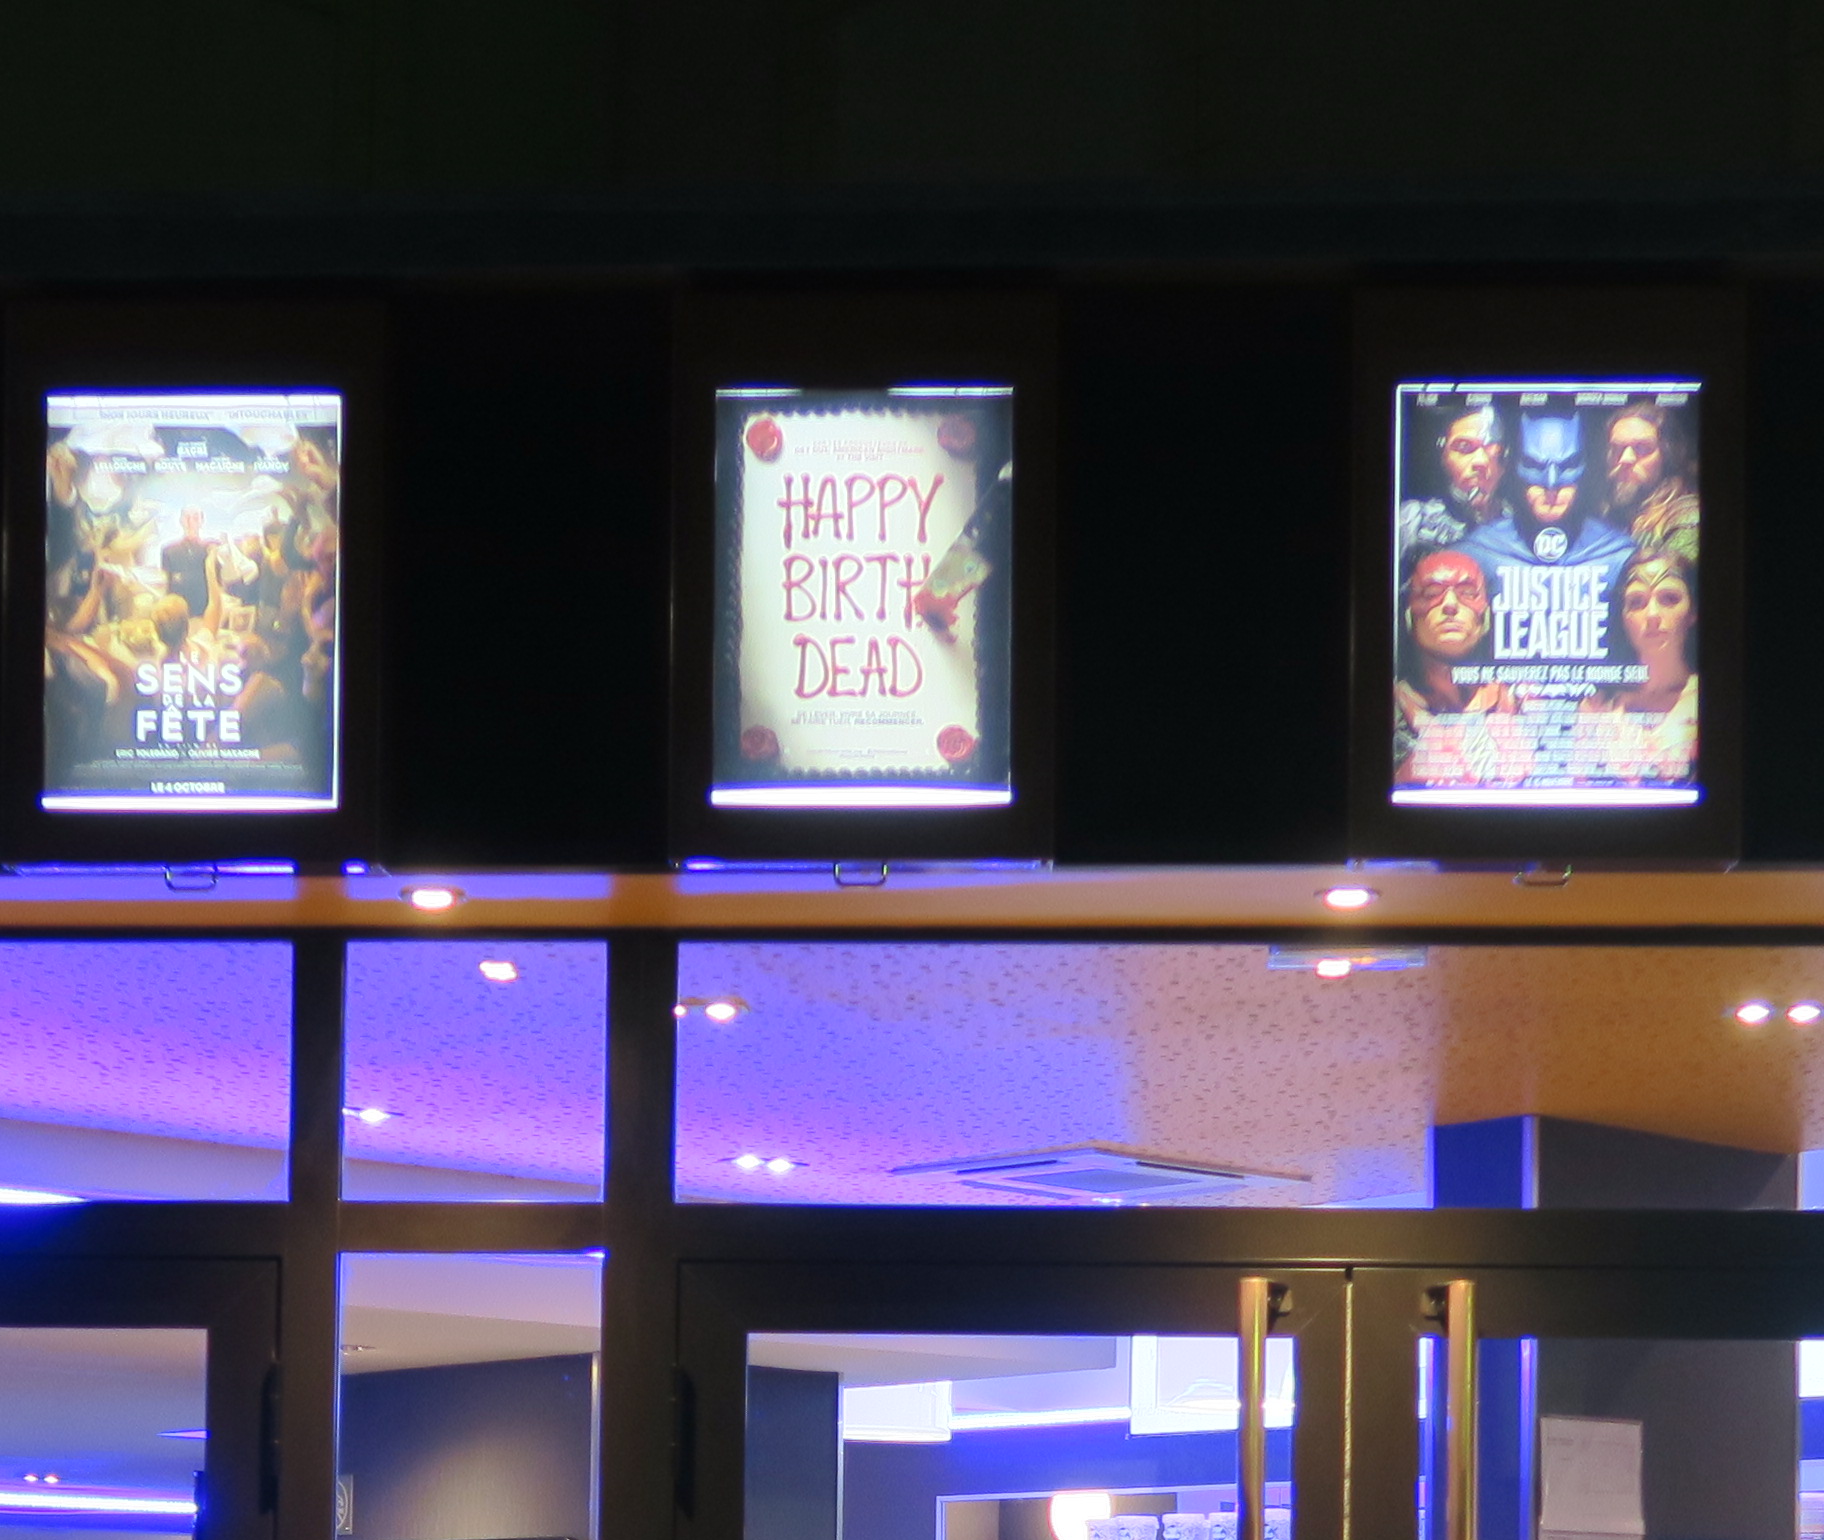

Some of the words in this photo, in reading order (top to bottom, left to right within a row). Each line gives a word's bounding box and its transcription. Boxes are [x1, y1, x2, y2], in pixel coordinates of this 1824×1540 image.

[777, 473, 945, 550] HAPPY
[782, 553, 932, 630] BIRTH
[1492, 565, 1610, 612] JUSTICE
[1493, 609, 1610, 660] LEAGUE
[135, 663, 243, 696] SENS
[179, 651, 200, 665] LE
[792, 633, 924, 699] DEAD
[162, 694, 184, 707] DE
[192, 694, 216, 708] LA
[136, 703, 242, 743] FÊTE
[151, 781, 164, 793] LE
[174, 782, 226, 794] OCTOBRE
